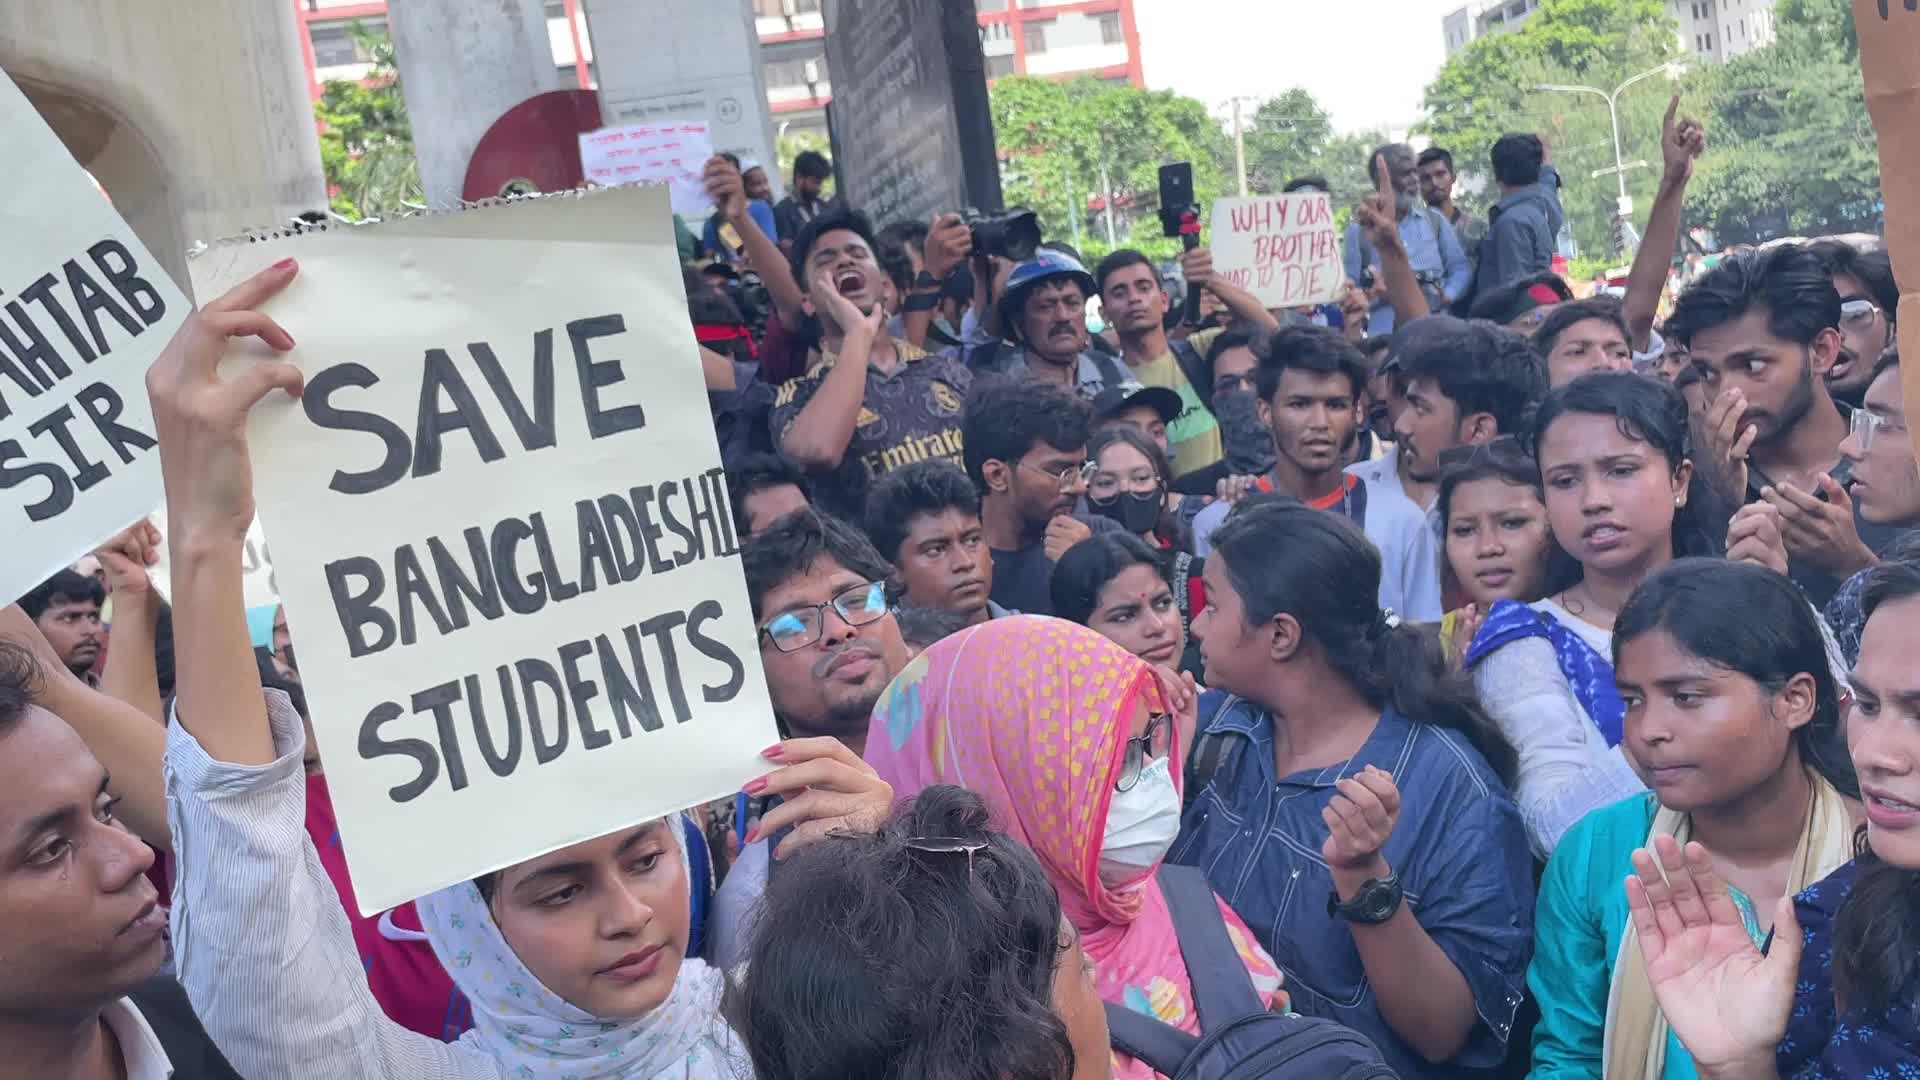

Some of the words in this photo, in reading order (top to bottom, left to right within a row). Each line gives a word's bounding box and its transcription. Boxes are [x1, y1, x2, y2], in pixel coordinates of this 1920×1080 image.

[1231, 199, 1288, 232] WHY
[1297, 197, 1331, 226] OUR
[1254, 230, 1337, 266] BROTHER
[0, 382, 159, 523] SIR
[302, 314, 646, 495] SAVE
[325, 467, 741, 658] BANGLADESHI
[358, 600, 745, 803] STUDENTS
